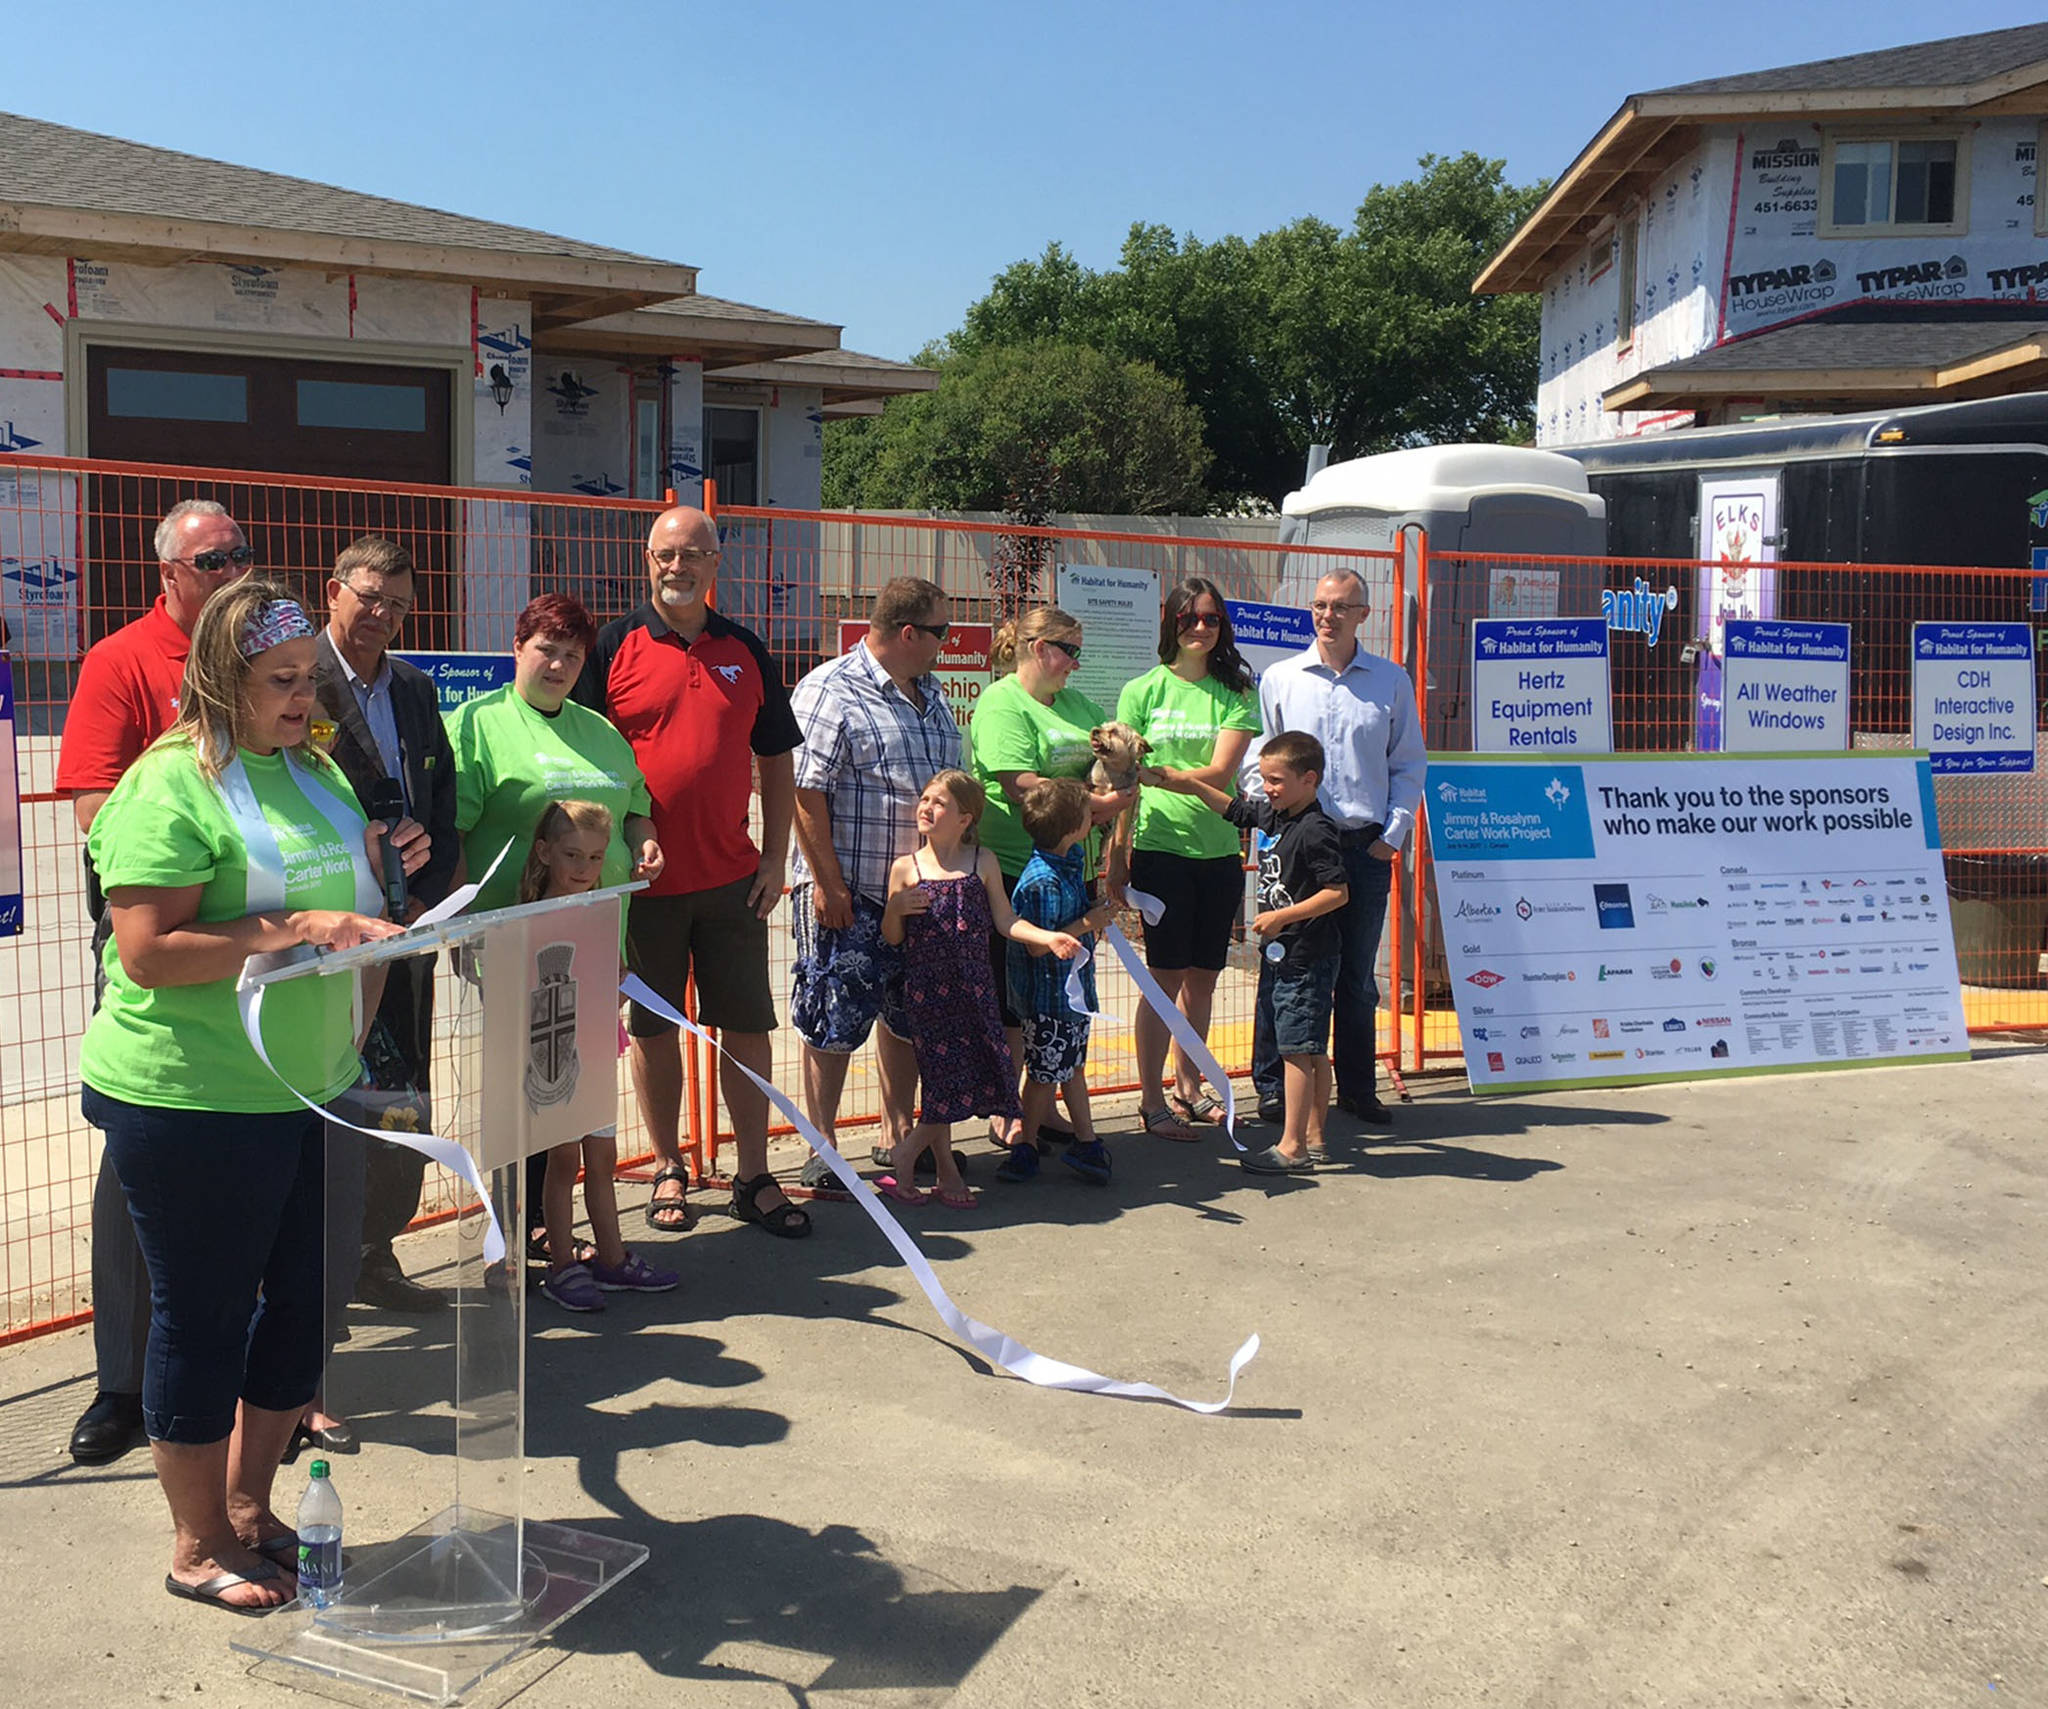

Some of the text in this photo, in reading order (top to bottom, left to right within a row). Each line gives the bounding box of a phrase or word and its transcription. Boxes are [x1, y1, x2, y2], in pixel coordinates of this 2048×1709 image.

[1752, 152, 1820, 169] MISSION
[1759, 172, 1802, 185] Building
[1729, 264, 1812, 296] TYPAR
[1856, 261, 1943, 293] TYPAR
[1732, 284, 1835, 313] HouseWrap
[1870, 281, 1966, 300] ouseWrap
[1715, 504, 1760, 532] ELKS
[1081, 577, 1148, 592] Habitat for Humanity
[1236, 607, 1302, 628] Proud Sponsor of
[951, 633, 961, 647] of
[1231, 623, 1265, 640] Habitat
[1266, 627, 1279, 641] for
[1505, 625, 1579, 638] Proud Sponsor of
[1754, 626, 1824, 641] Proud Sponsor of
[1940, 628, 2006, 641] Proud Sponsor of
[1499, 640, 1604, 655] Habitat for Humanity
[1748, 641, 1845, 659] Habitat for Humanity
[1935, 643, 2028, 657] Habitat for Humanity
[936, 651, 988, 667] Humanity
[438, 663, 480, 681] Sponsor
[483, 665, 495, 682] of
[1518, 671, 1565, 689] Hertz
[1957, 670, 1991, 689] CDH
[445, 685, 464, 703] for
[1737, 683, 1837, 704] All Weather
[1491, 697, 1593, 721] Equipment
[1934, 696, 2015, 716] Interactive
[1748, 709, 1825, 731] Windows
[1509, 726, 1578, 746] Rentals
[1933, 723, 2015, 745] Design Inc.
[1945, 757, 1961, 770] You
[1962, 758, 1974, 769] for
[1976, 756, 1997, 768] Your
[1598, 785, 1890, 812] Thank you to the sponsors
[1443, 812, 1541, 827] Jimmy & Rosalynn
[1603, 808, 1913, 835] who make our work possible
[1444, 826, 1551, 841] Carter Work Project
[282, 849, 320, 866] Jimmy
[318, 844, 328, 857] &
[284, 857, 351, 884] Carter Work
[1451, 870, 1485, 879] Platinum
[1719, 866, 1748, 875] Canada
[1463, 944, 1481, 954] Gold
[1731, 938, 1757, 947] Bronze
[1472, 1006, 1494, 1016] Silver
